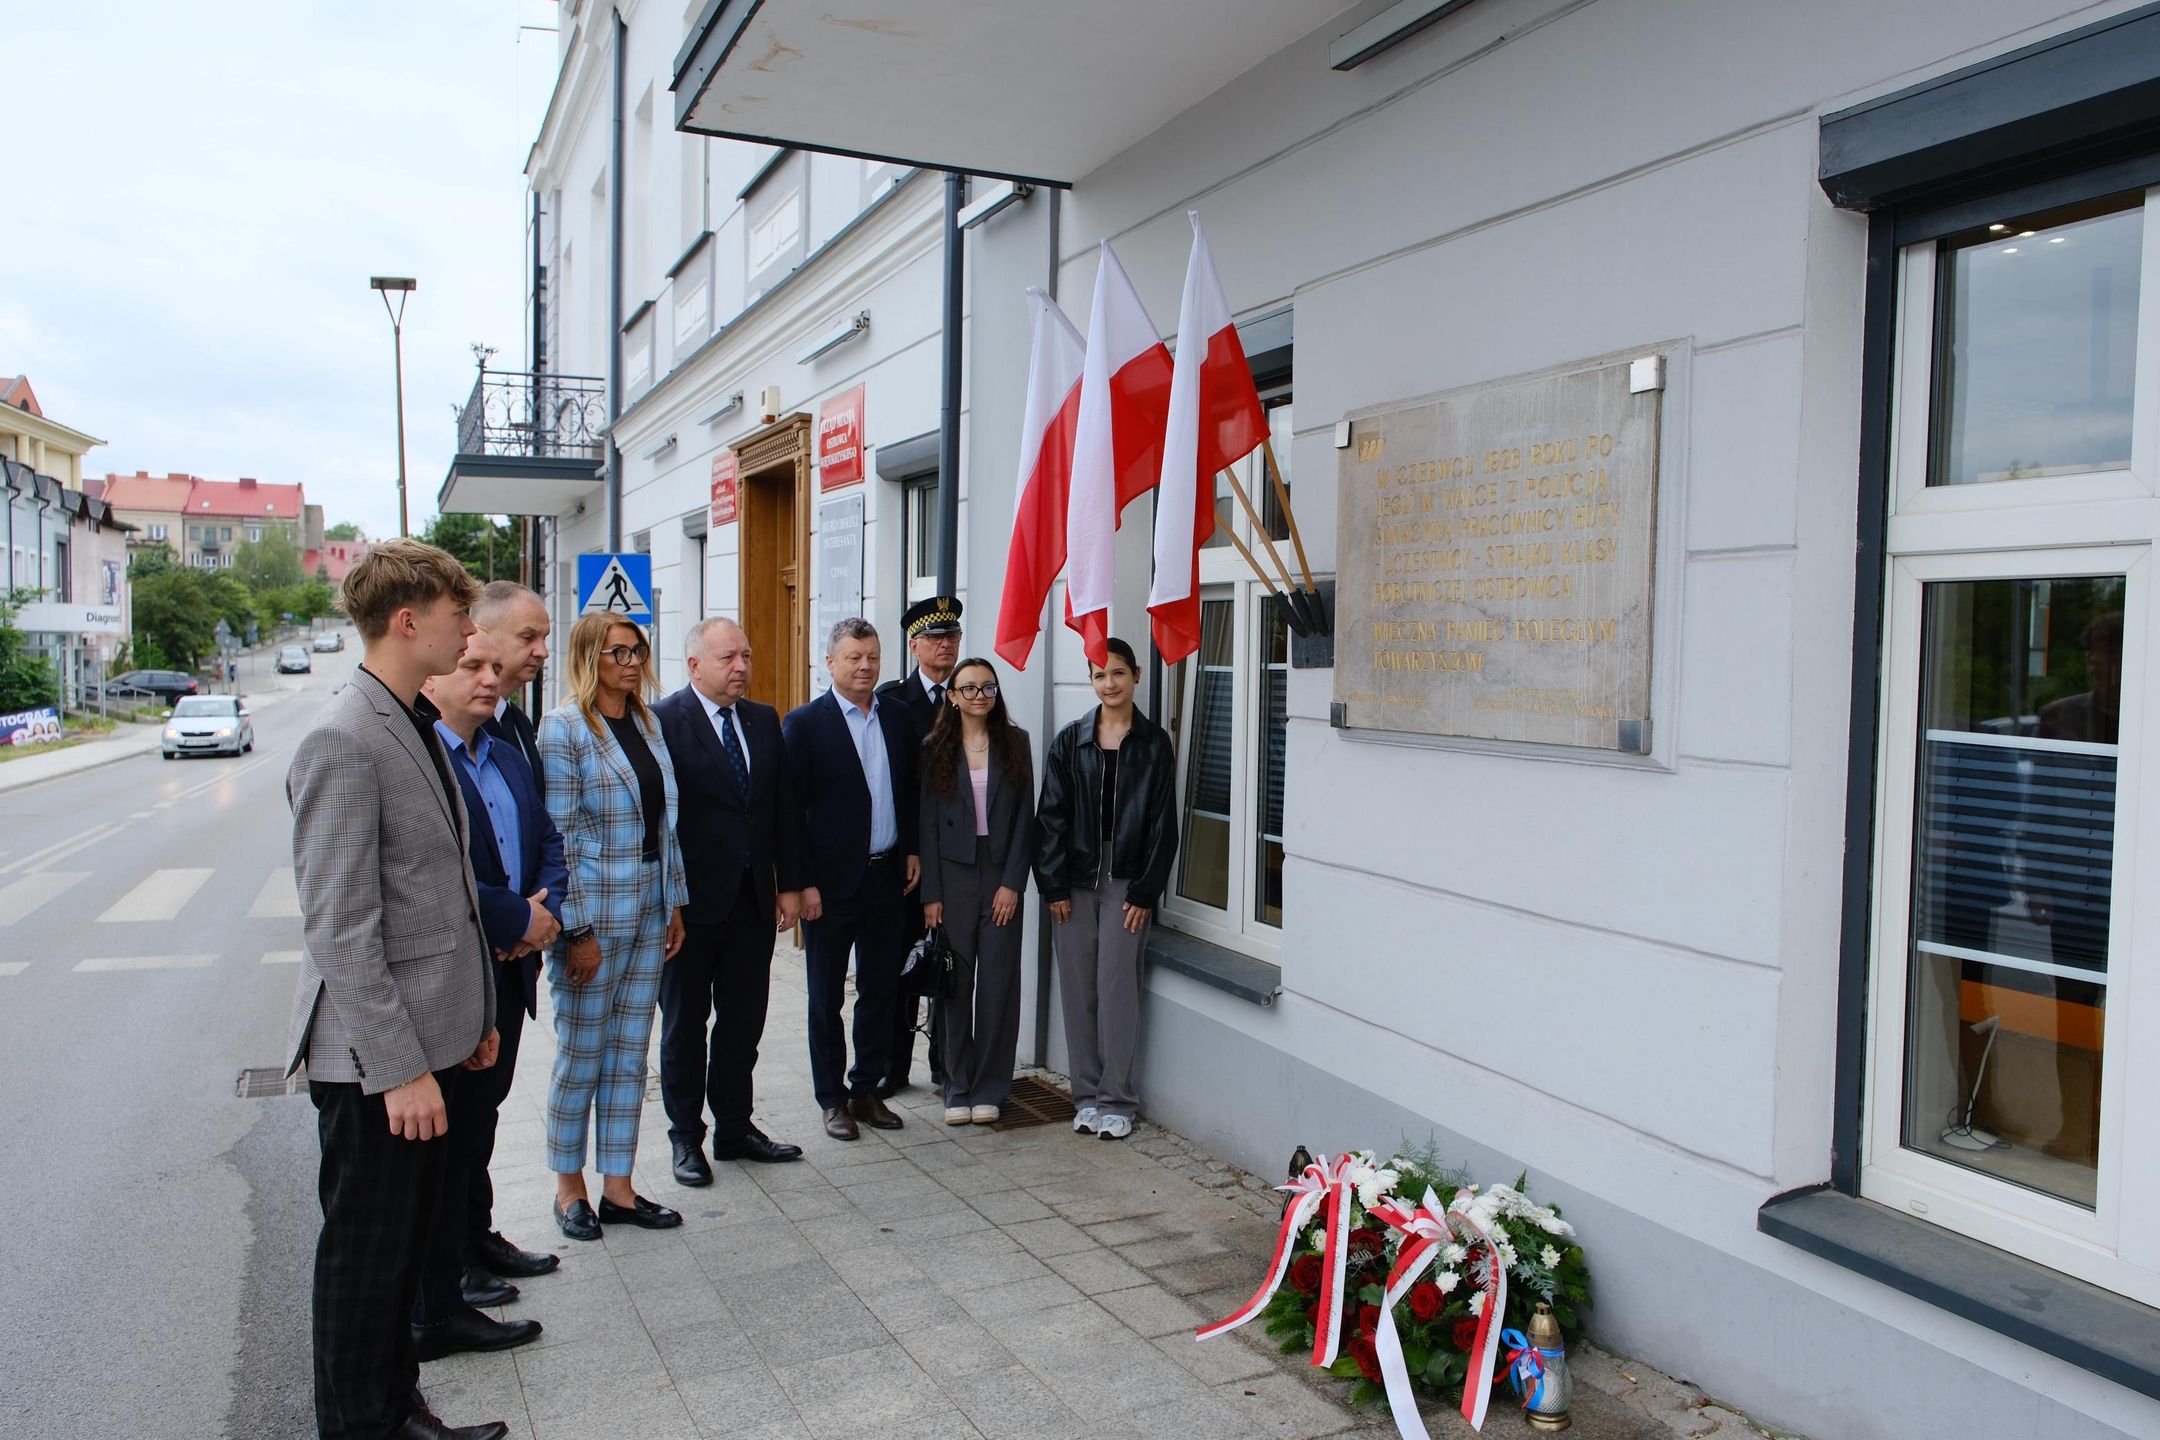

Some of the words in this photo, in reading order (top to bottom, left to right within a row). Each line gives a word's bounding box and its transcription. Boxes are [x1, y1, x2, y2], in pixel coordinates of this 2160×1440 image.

[1376, 467, 1389, 490] W
[1397, 455, 1475, 487] CZERWCU
[1531, 438, 1578, 468] ROKU
[1586, 432, 1623, 461] PO-
[1420, 490, 1435, 513] W
[1444, 482, 1499, 511] WALCE
[1506, 479, 1518, 505] Z
[1459, 506, 1565, 541] PRACOWNICY
[1573, 501, 1621, 531] HUTY
[1561, 537, 1618, 566] KLASY
[1373, 620, 1438, 643] WIECZNA
[1515, 617, 1618, 643] POLEGŁYM
[1373, 649, 1484, 674] TOWARZYSZOM
[0, 708, 50, 728] TOGRAF
